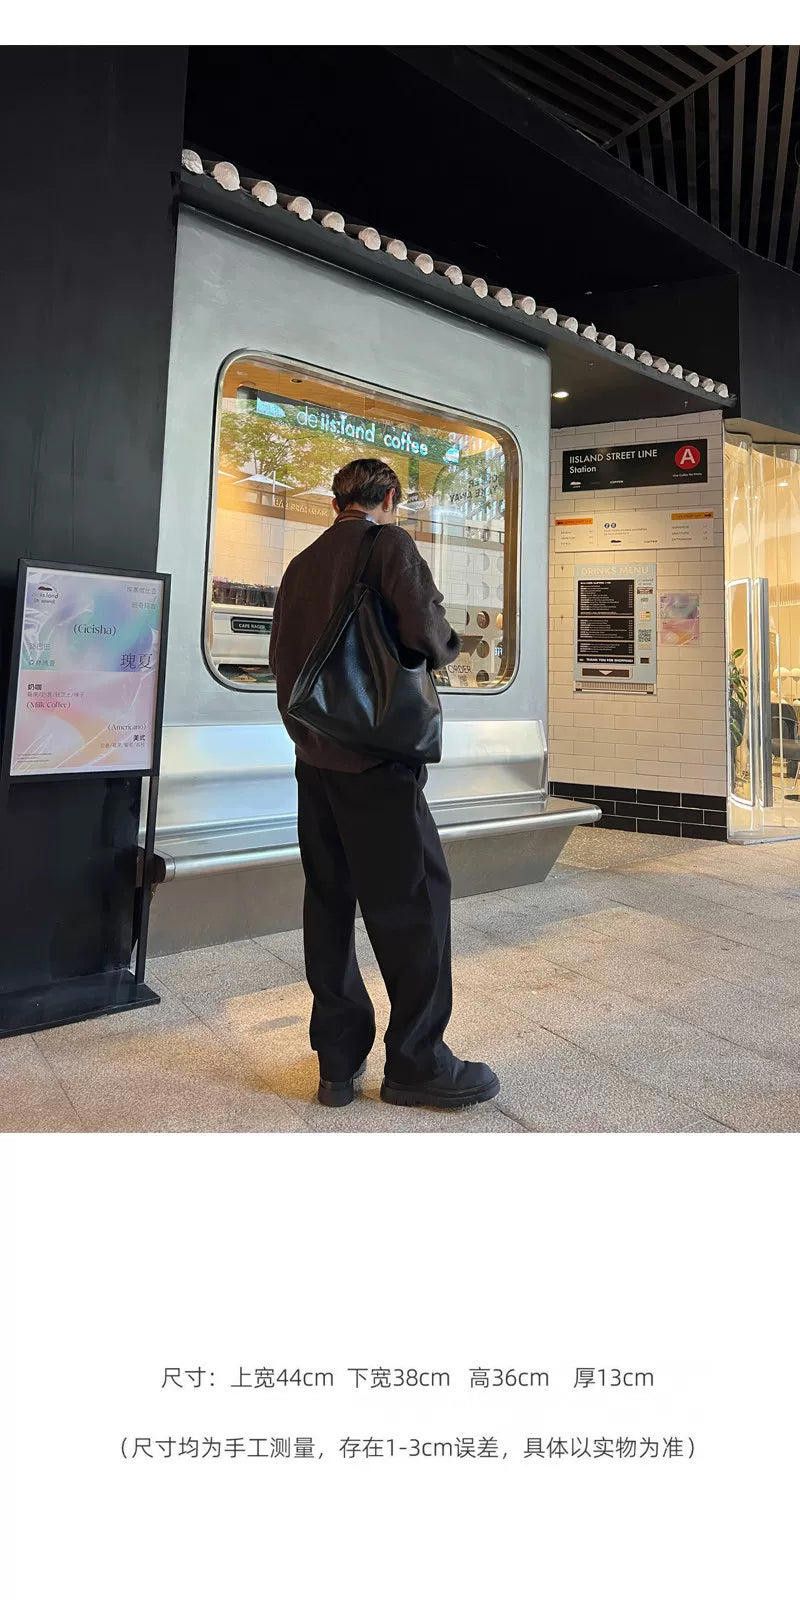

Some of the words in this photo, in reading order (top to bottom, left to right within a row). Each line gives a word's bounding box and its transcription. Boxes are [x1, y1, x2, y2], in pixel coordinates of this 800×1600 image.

[383, 432, 428, 456] coffee
[569, 453, 604, 464] IISLAND
[606, 450, 636, 461] STREET
[638, 448, 658, 459] LINE
[680, 448, 696, 465] A
[569, 465, 597, 475] Station
[581, 566, 617, 576] DRINKS
[73, 624, 117, 637] (Geisha)
[121, 652, 153, 669] 瑰夏
